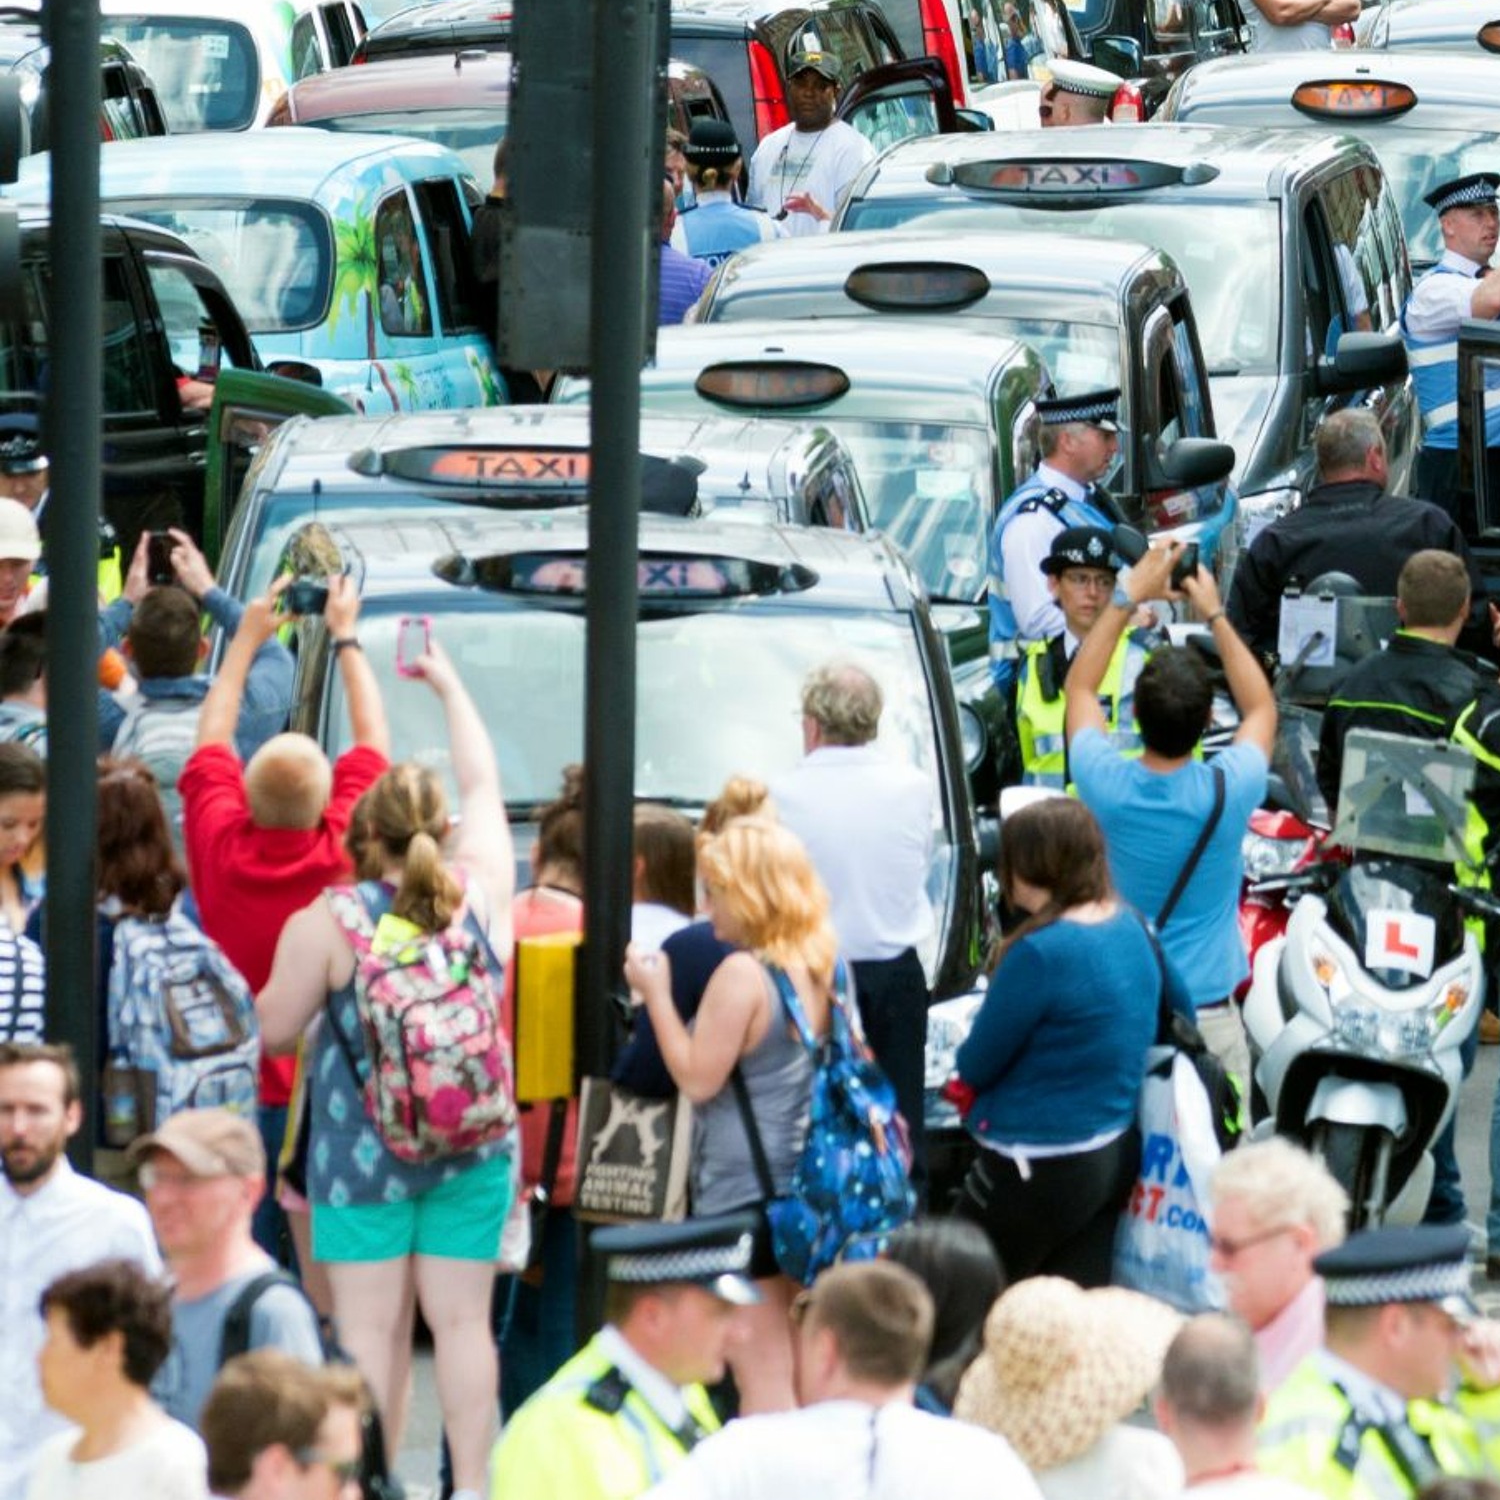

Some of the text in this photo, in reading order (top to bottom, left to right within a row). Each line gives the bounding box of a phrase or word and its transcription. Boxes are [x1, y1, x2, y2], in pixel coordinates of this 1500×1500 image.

[1021, 166, 1110, 185] TAXI
[468, 455, 576, 479] TAXI
[1386, 921, 1419, 959] L
[581, 1176, 654, 1199] ANIMAL
[581, 1192, 653, 1216] TESTING
